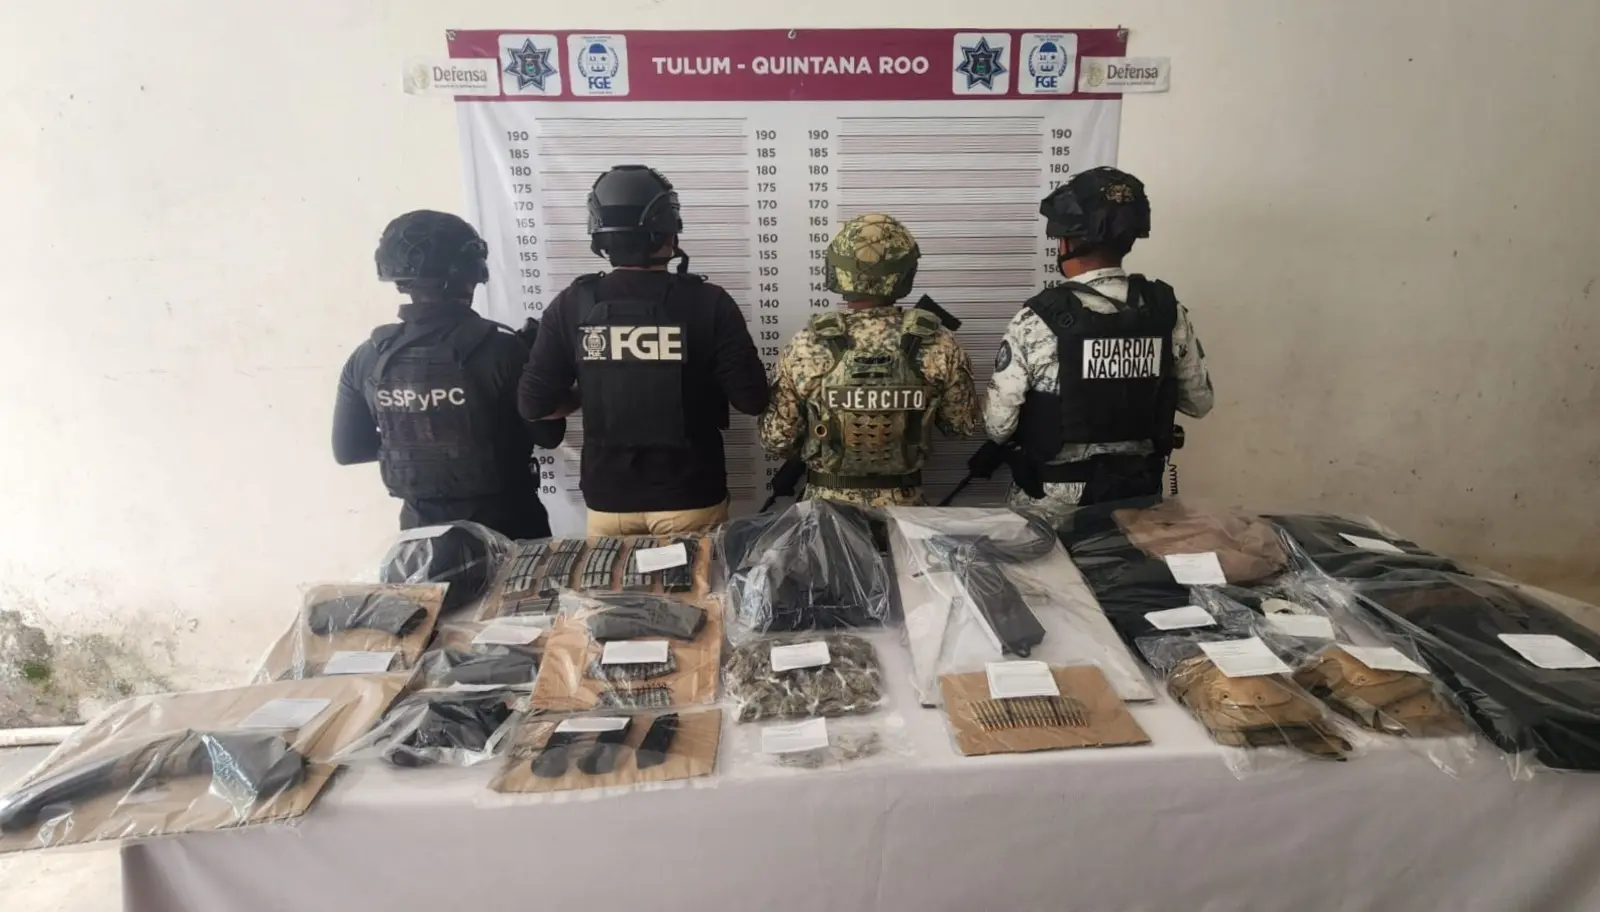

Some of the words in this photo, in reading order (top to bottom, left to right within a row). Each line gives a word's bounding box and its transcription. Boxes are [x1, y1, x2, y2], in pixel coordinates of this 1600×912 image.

[652, 56, 731, 74] TULUM
[752, 56, 872, 75] QUINTANA
[879, 56, 929, 74] ROO
[433, 66, 488, 82] Defensa
[1107, 64, 1158, 79] Defensa
[588, 76, 611, 90] FGE
[1035, 75, 1058, 88] FGE
[507, 131, 529, 141] 190
[755, 130, 777, 140] 190
[808, 130, 829, 140] 190
[1051, 129, 1072, 139] 190
[510, 149, 530, 159] 185
[757, 148, 776, 158] 185
[808, 148, 828, 157] 185
[1051, 147, 1070, 156] 185
[510, 166, 532, 176] 180
[756, 166, 777, 176] 180
[808, 165, 829, 175] 180
[1049, 164, 1070, 173] 180
[512, 184, 532, 194] 175
[757, 183, 776, 193] 175
[809, 182, 828, 192] 175
[514, 201, 534, 211] 170
[757, 200, 777, 210] 170
[808, 199, 829, 209] 170
[516, 218, 535, 228] 165
[758, 217, 777, 226] 165
[809, 217, 829, 226] 165
[516, 235, 537, 245] 160
[758, 234, 778, 243] 160
[809, 233, 829, 243] 160
[759, 250, 778, 260] 155
[809, 250, 828, 259] 155
[1044, 247, 1060, 256] 15
[519, 252, 538, 262] 155
[521, 269, 541, 278] 150
[758, 267, 779, 276] 150
[522, 285, 542, 295] 145
[759, 283, 779, 293] 145
[523, 302, 543, 311] 140
[759, 299, 780, 309] 140
[809, 299, 829, 308] 140
[760, 316, 779, 324] 135
[760, 331, 779, 340] 130
[610, 326, 682, 360] FGE
[761, 347, 779, 355] 125
[1091, 339, 1155, 359] GUARDIA
[1087, 358, 1157, 378] NACIONAL
[377, 387, 466, 411] SSPyPC
[828, 387, 923, 409] EJÉRCITO
[540, 456, 555, 465] 90
[541, 471, 555, 479] 85
[542, 485, 557, 494] 80
